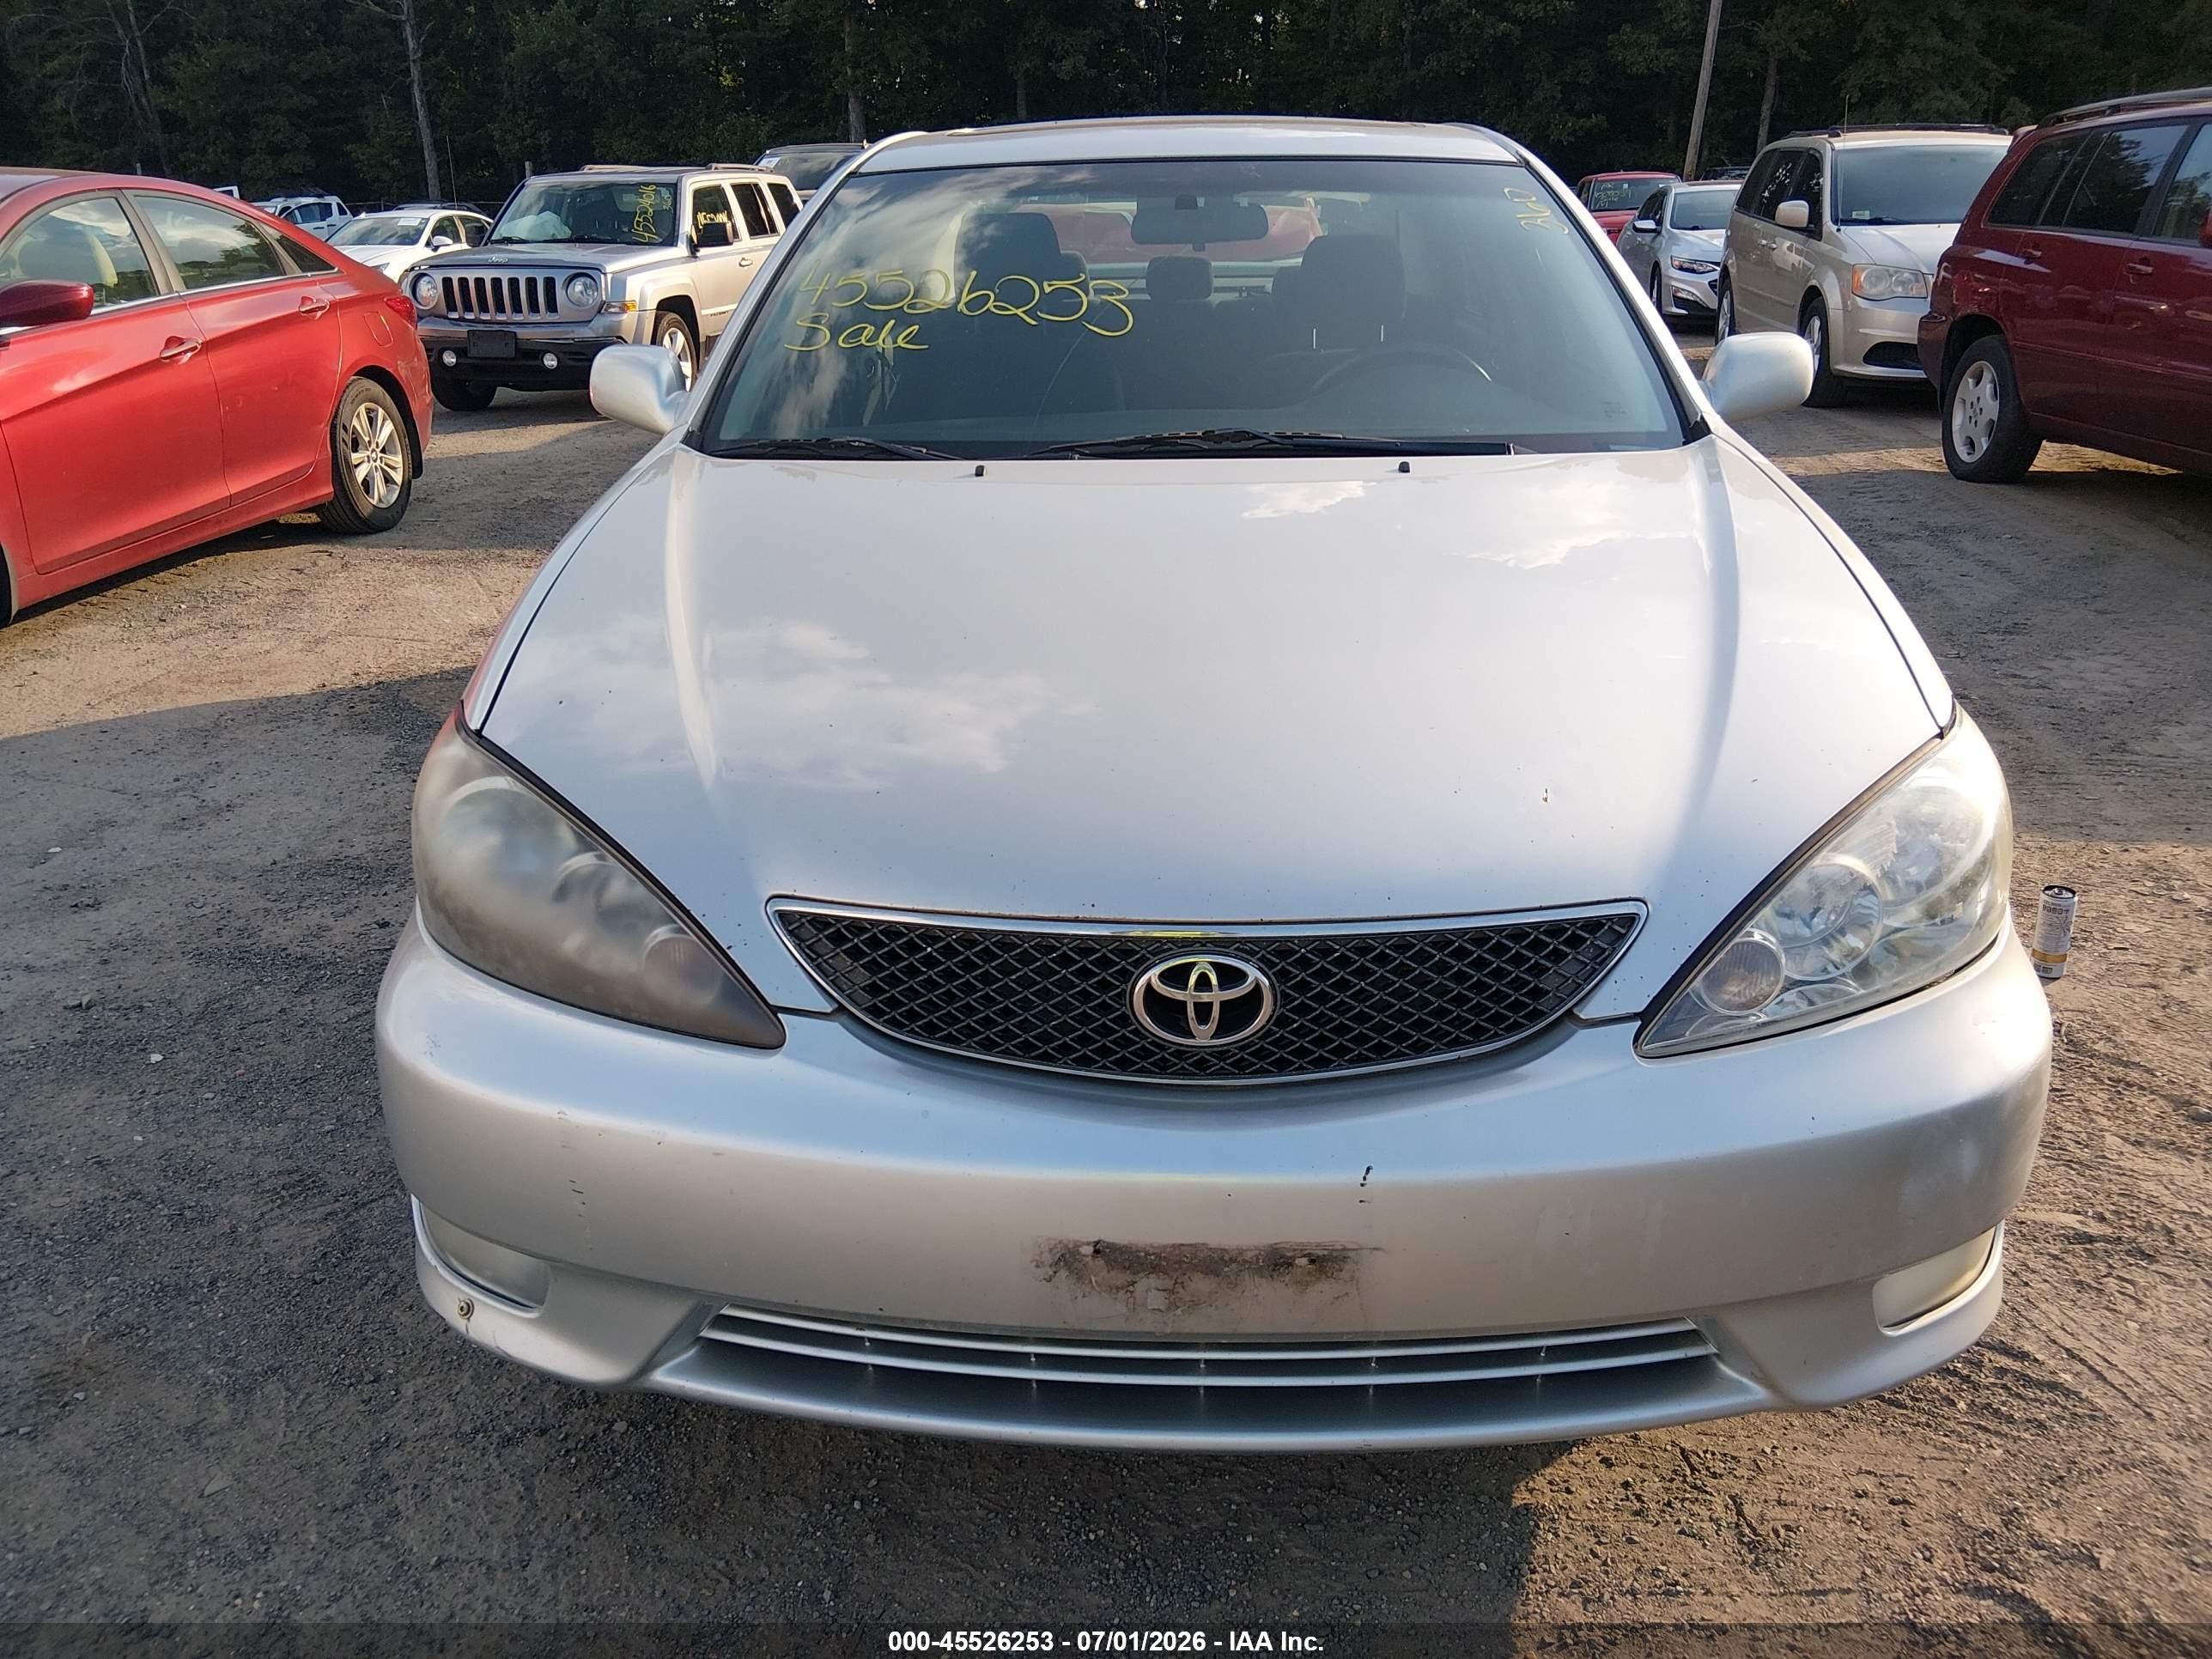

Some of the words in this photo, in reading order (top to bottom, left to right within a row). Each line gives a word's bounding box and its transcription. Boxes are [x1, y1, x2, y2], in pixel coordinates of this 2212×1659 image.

[632, 185, 663, 243] 45524016
[799, 260, 1133, 337] 45526253
[784, 313, 929, 351] Sale
